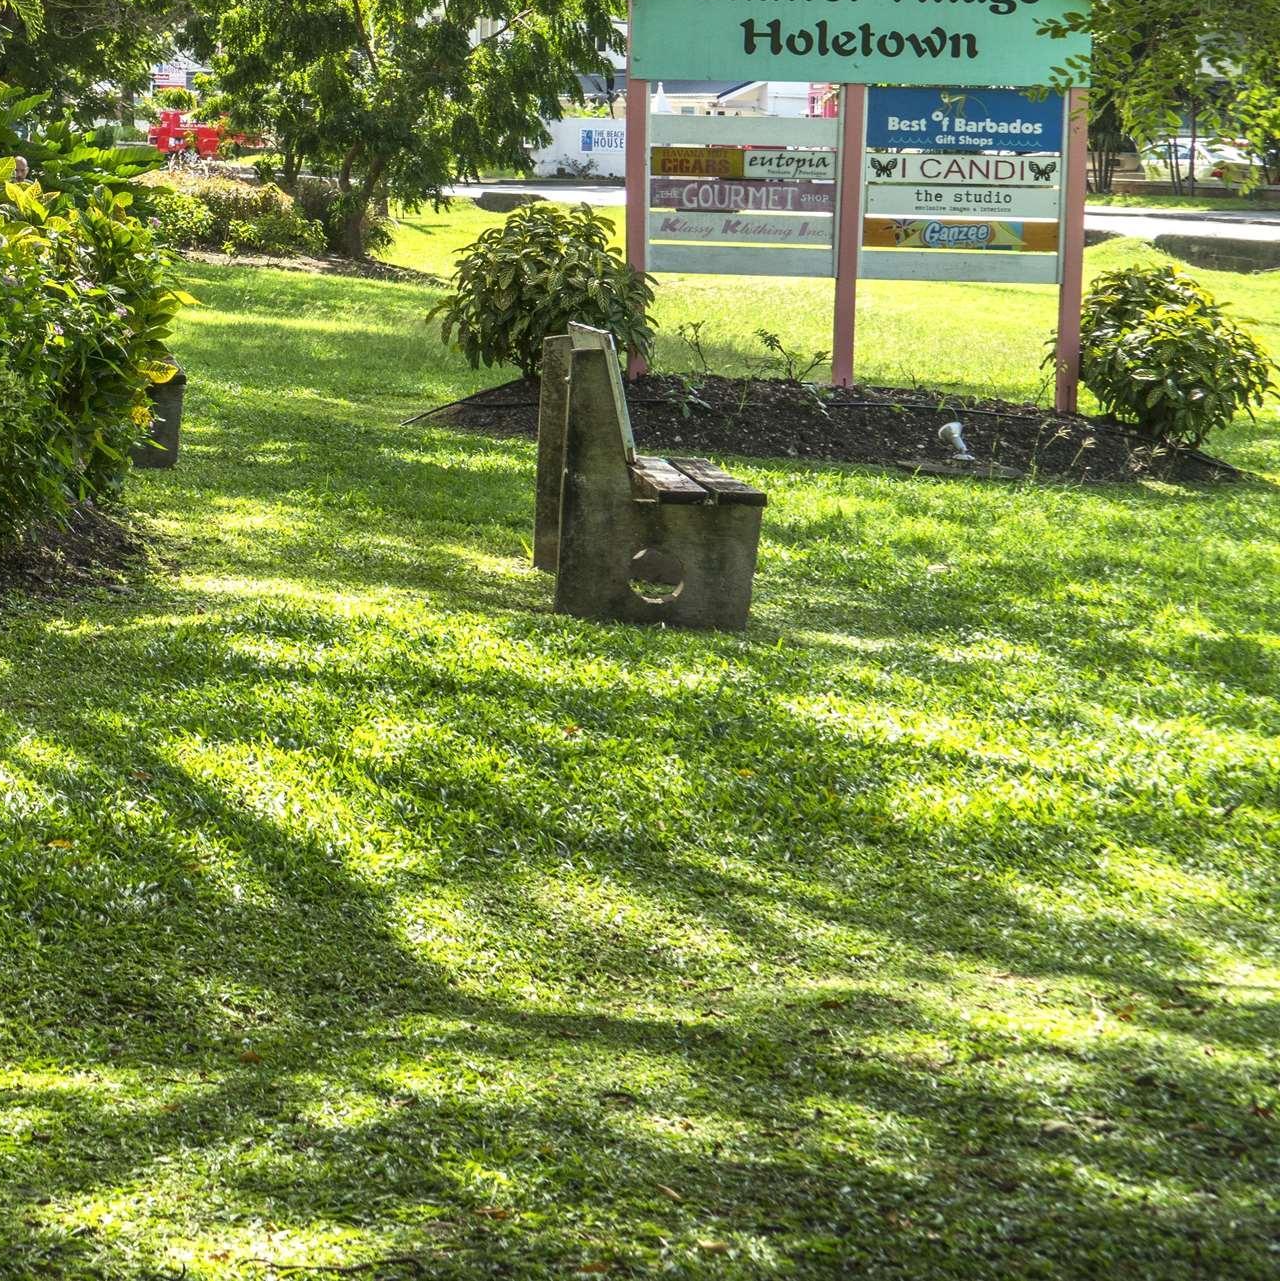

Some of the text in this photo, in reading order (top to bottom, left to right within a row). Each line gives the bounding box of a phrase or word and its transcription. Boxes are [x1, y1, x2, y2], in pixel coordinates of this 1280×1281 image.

[739, 19, 979, 59] Holetown
[594, 130, 625, 138] THE BEACH
[887, 111, 1043, 135] Best of Barbados
[594, 137, 625, 149] HOUSE
[935, 135, 993, 147] Gift Shops
[749, 152, 830, 178] eutopia
[901, 158, 1025, 181] I CANDI
[682, 182, 799, 210] GOURMET
[800, 193, 830, 204] SHOP
[915, 189, 1013, 204] the studio
[924, 221, 989, 243] Ganzee
